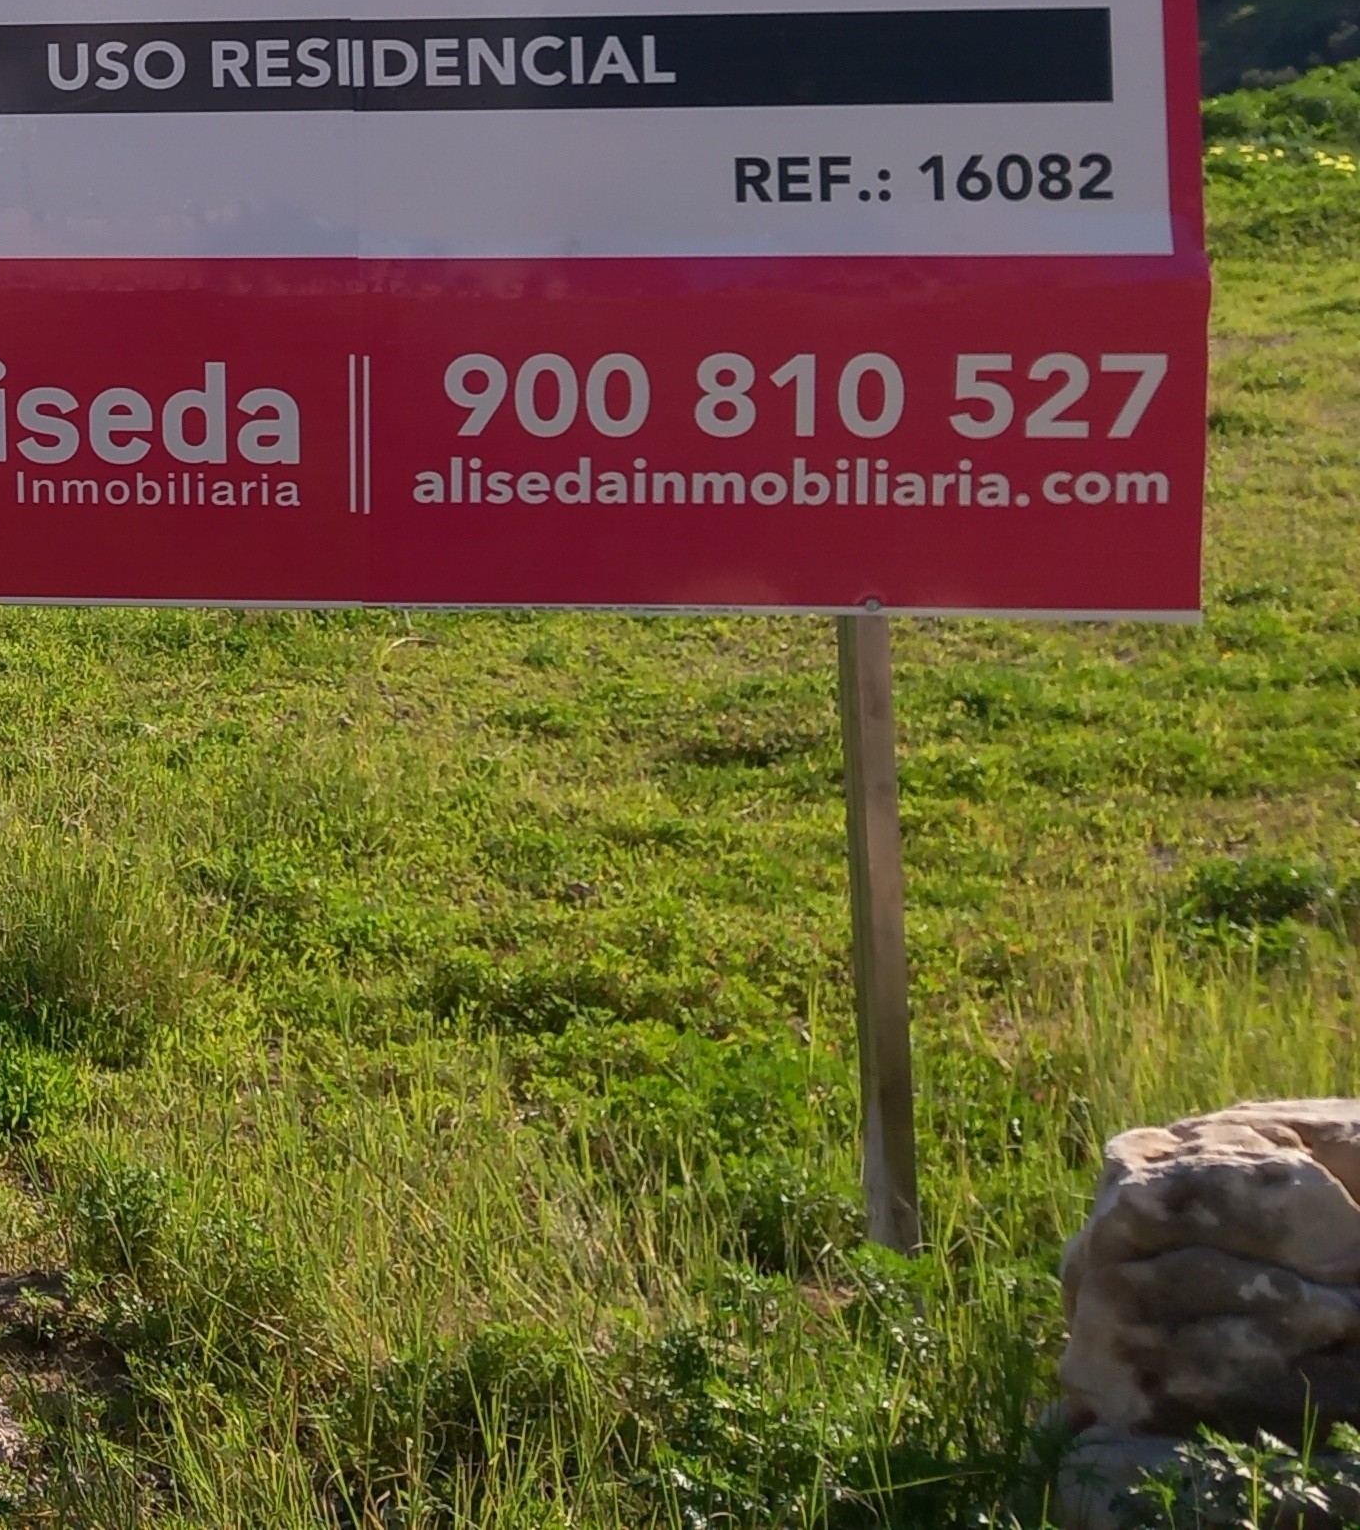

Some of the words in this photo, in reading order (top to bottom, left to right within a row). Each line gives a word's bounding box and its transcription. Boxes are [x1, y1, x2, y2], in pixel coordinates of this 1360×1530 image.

[47, 40, 186, 90] USO
[734, 156, 893, 203] REF.:
[918, 152, 1115, 202] 16082
[444, 352, 651, 438] 900
[694, 352, 905, 438] 810
[949, 353, 1169, 439] 527
[17, 470, 302, 507] Inmobiliaria
